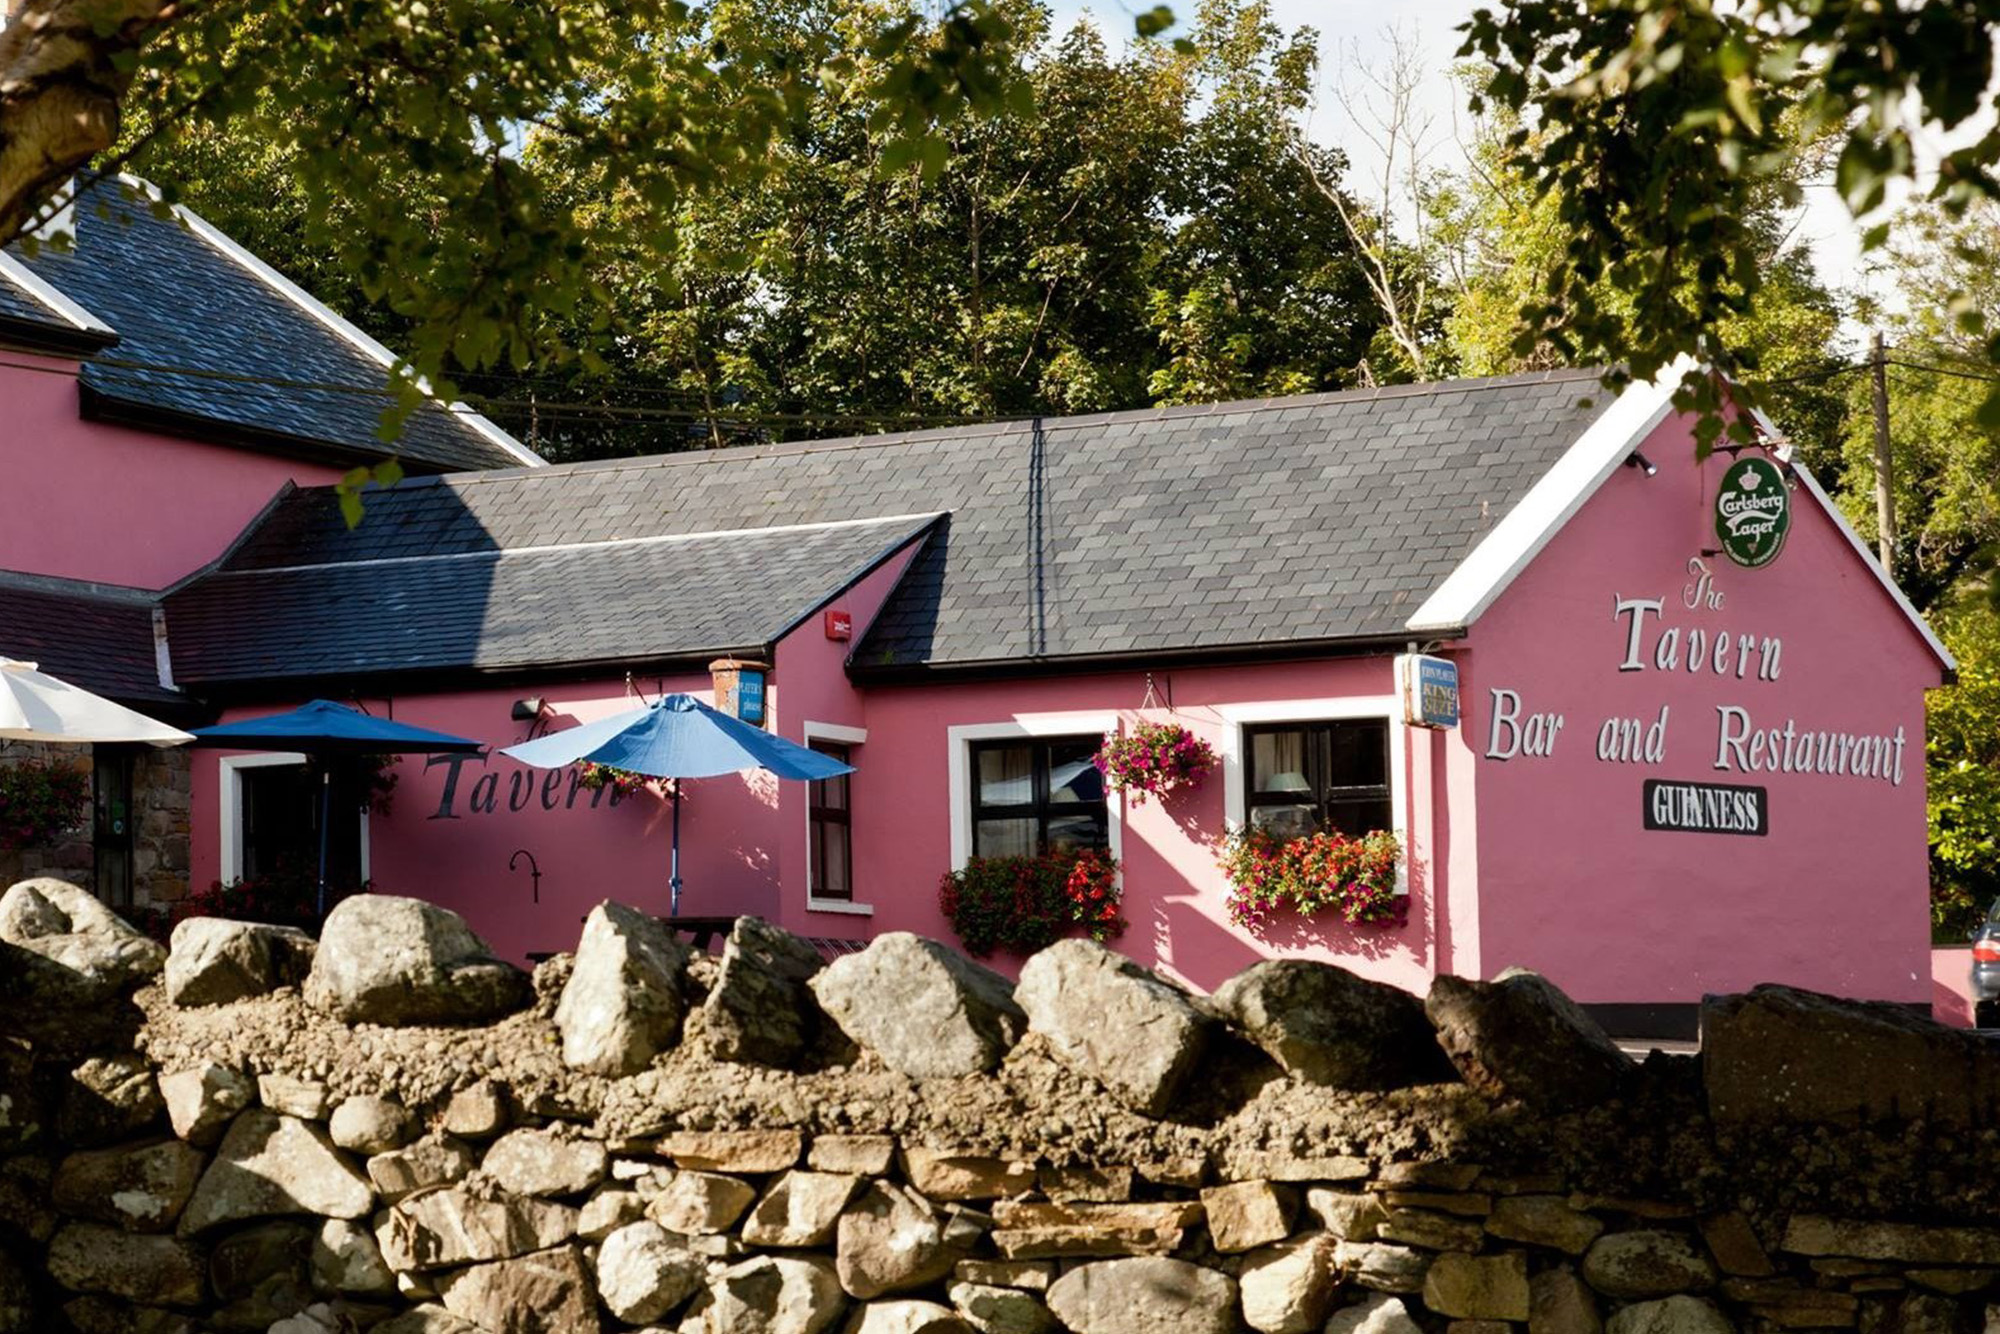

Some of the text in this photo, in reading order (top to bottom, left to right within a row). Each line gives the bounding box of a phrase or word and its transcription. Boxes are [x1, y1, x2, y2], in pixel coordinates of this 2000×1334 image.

[1719, 491, 1783, 518] Carlsberg
[1731, 519, 1776, 543] Lager
[1683, 557, 1726, 612] The
[1613, 593, 1783, 681] Tavern
[1422, 698, 1456, 717] SIZE
[1424, 683, 1456, 701] KING
[1485, 687, 1907, 786] Bar and Restaurant
[1652, 785, 1760, 832] GUINNESS
